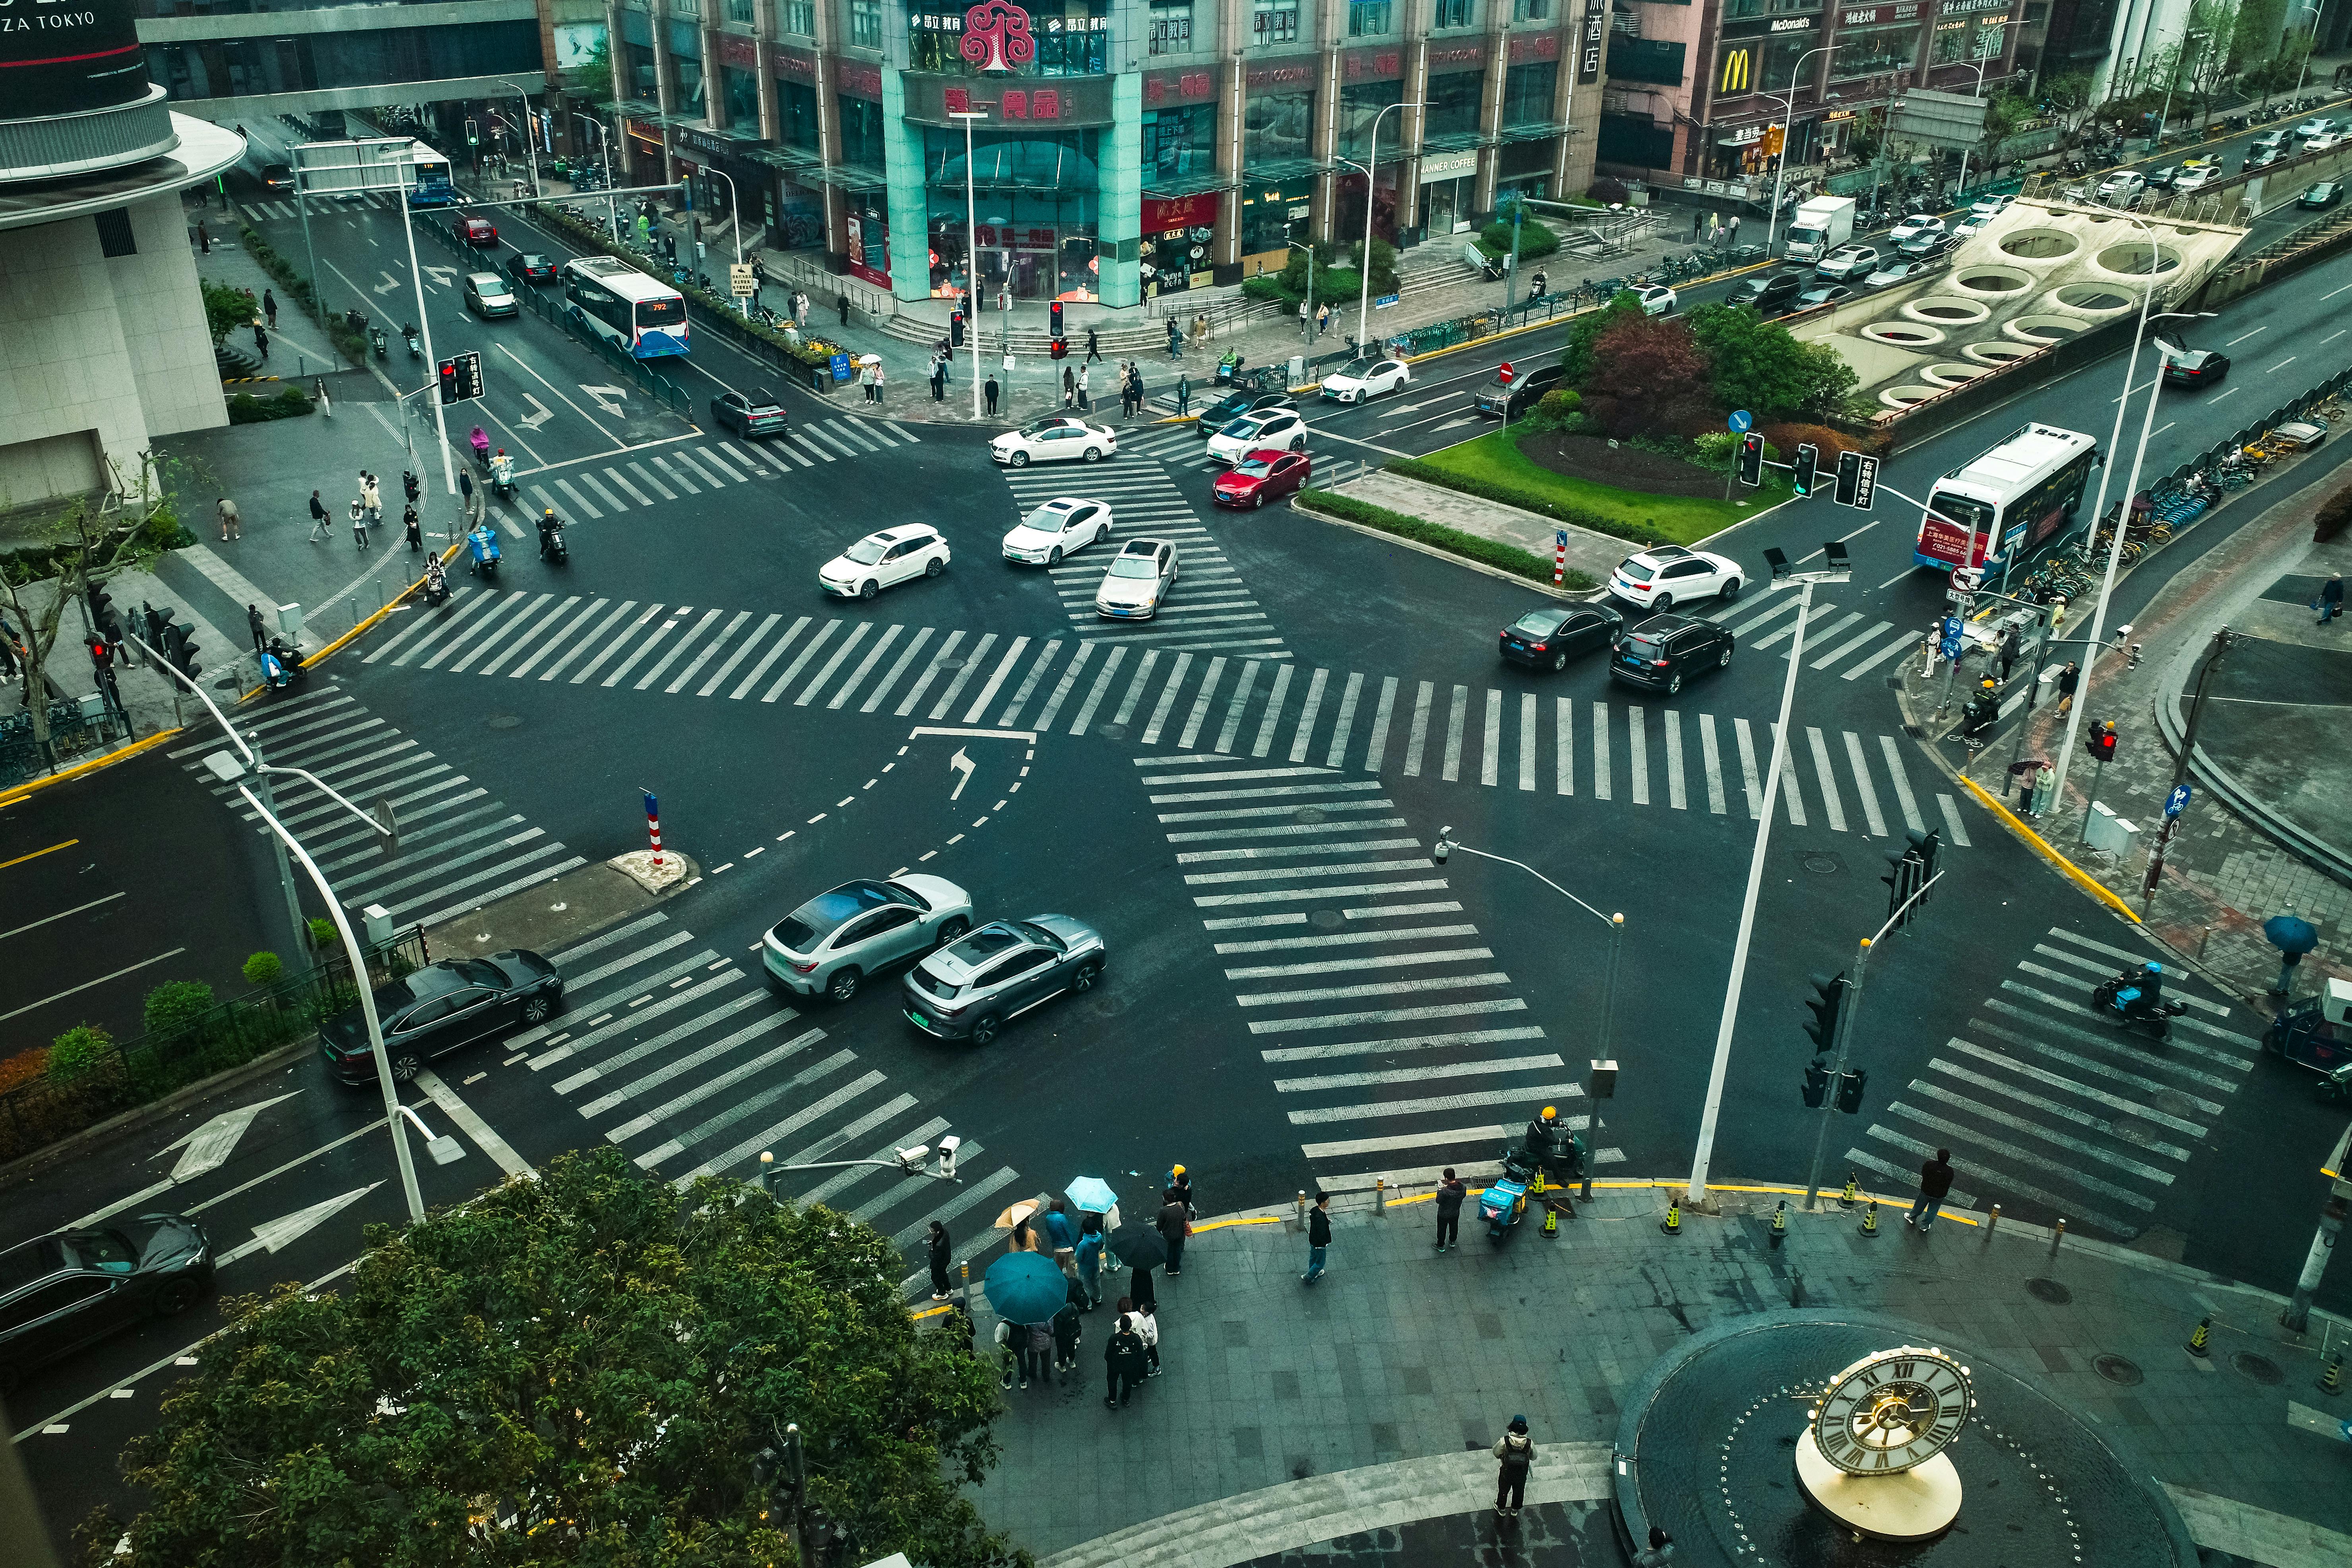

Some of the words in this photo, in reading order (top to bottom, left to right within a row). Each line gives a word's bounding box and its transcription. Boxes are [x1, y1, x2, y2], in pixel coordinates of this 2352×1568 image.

[36, 12, 94, 29] TOKYO
[1770, 18, 1809, 31] McDonald's
[1148, 74, 1209, 101] 第一食品
[945, 89, 1059, 119] 第一食品
[1735, 126, 1760, 141] 麦当劳
[1421, 163, 1448, 174] MANNER
[1450, 157, 1476, 170] COFFEE
[1455, 220, 1470, 229] MANNER
[469, 357, 480, 395] 右转信号灯
[1858, 461, 1874, 505] 右转信号灯
[1927, 531, 1984, 550] 上海华美医疗美医院
[1936, 544, 1959, 554] 021-5885
[1949, 592, 1970, 604] 大型号牌
[1894, 1363, 1915, 1378] XII
[1925, 1368, 1941, 1382] I
[1860, 1371, 1881, 1389] XI
[1939, 1382, 1960, 1397] II
[1838, 1395, 1858, 1406] X
[1941, 1405, 1962, 1418] III
[1825, 1414, 1845, 1427] IX
[1924, 1424, 1952, 1446] IIII
[1907, 1447, 1920, 1460] V
